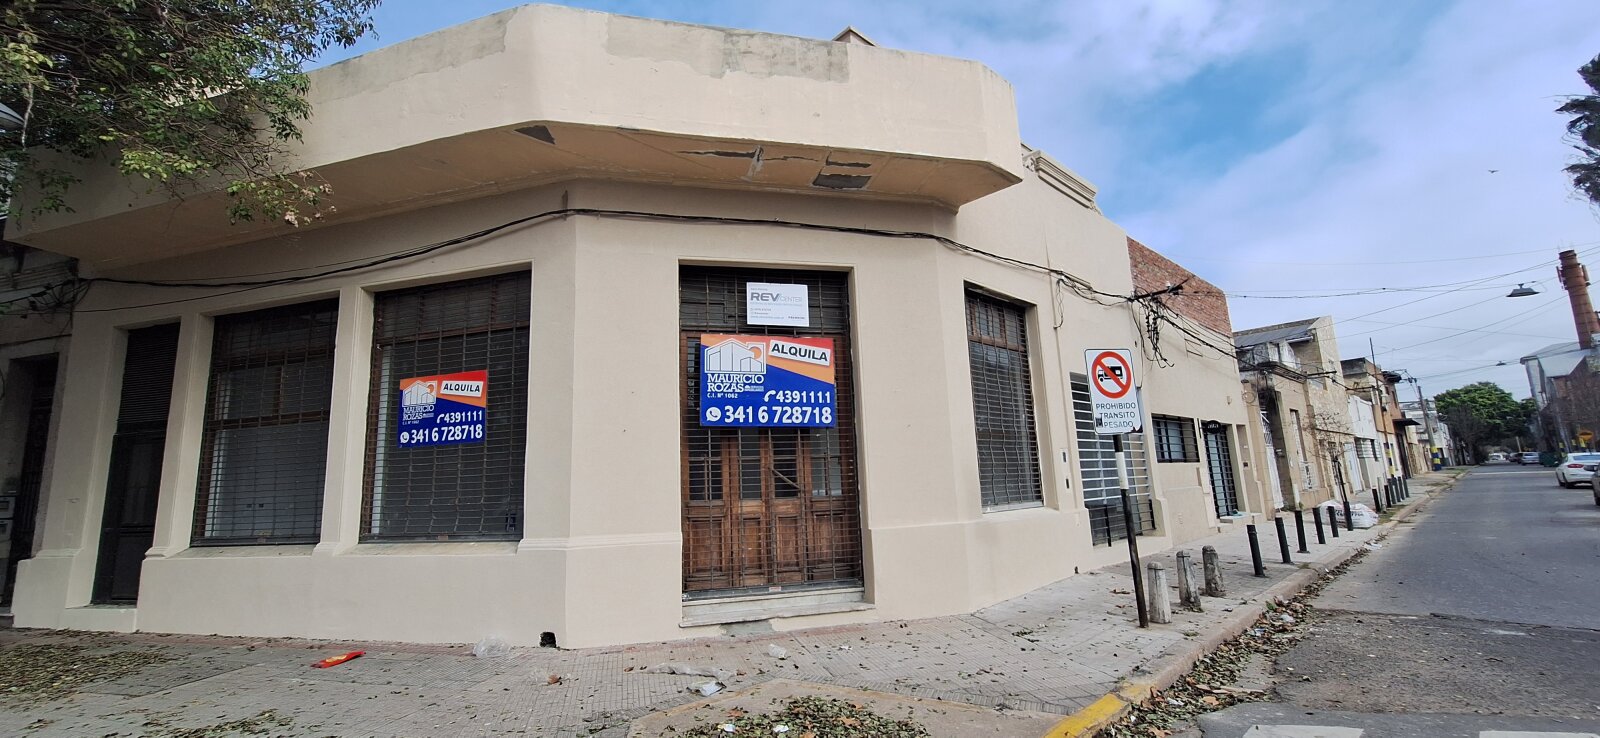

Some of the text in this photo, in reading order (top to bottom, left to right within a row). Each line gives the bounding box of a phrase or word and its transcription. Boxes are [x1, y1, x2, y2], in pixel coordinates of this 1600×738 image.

[771, 343, 828, 361] ALQUILA
[707, 374, 764, 384] MAURICIO
[443, 383, 480, 392] ALQUILA
[707, 382, 744, 393] ROZAS
[775, 390, 831, 403] 4391111
[403, 405, 434, 413] MAURICIO
[1096, 402, 1136, 410] PROHIBIDO
[444, 410, 482, 424] 4391111
[724, 405, 832, 424] 341 6 728718
[1100, 411, 1136, 419] TRANSITO
[1104, 420, 1134, 428] PESADO
[411, 424, 483, 444] 341 6 728718
